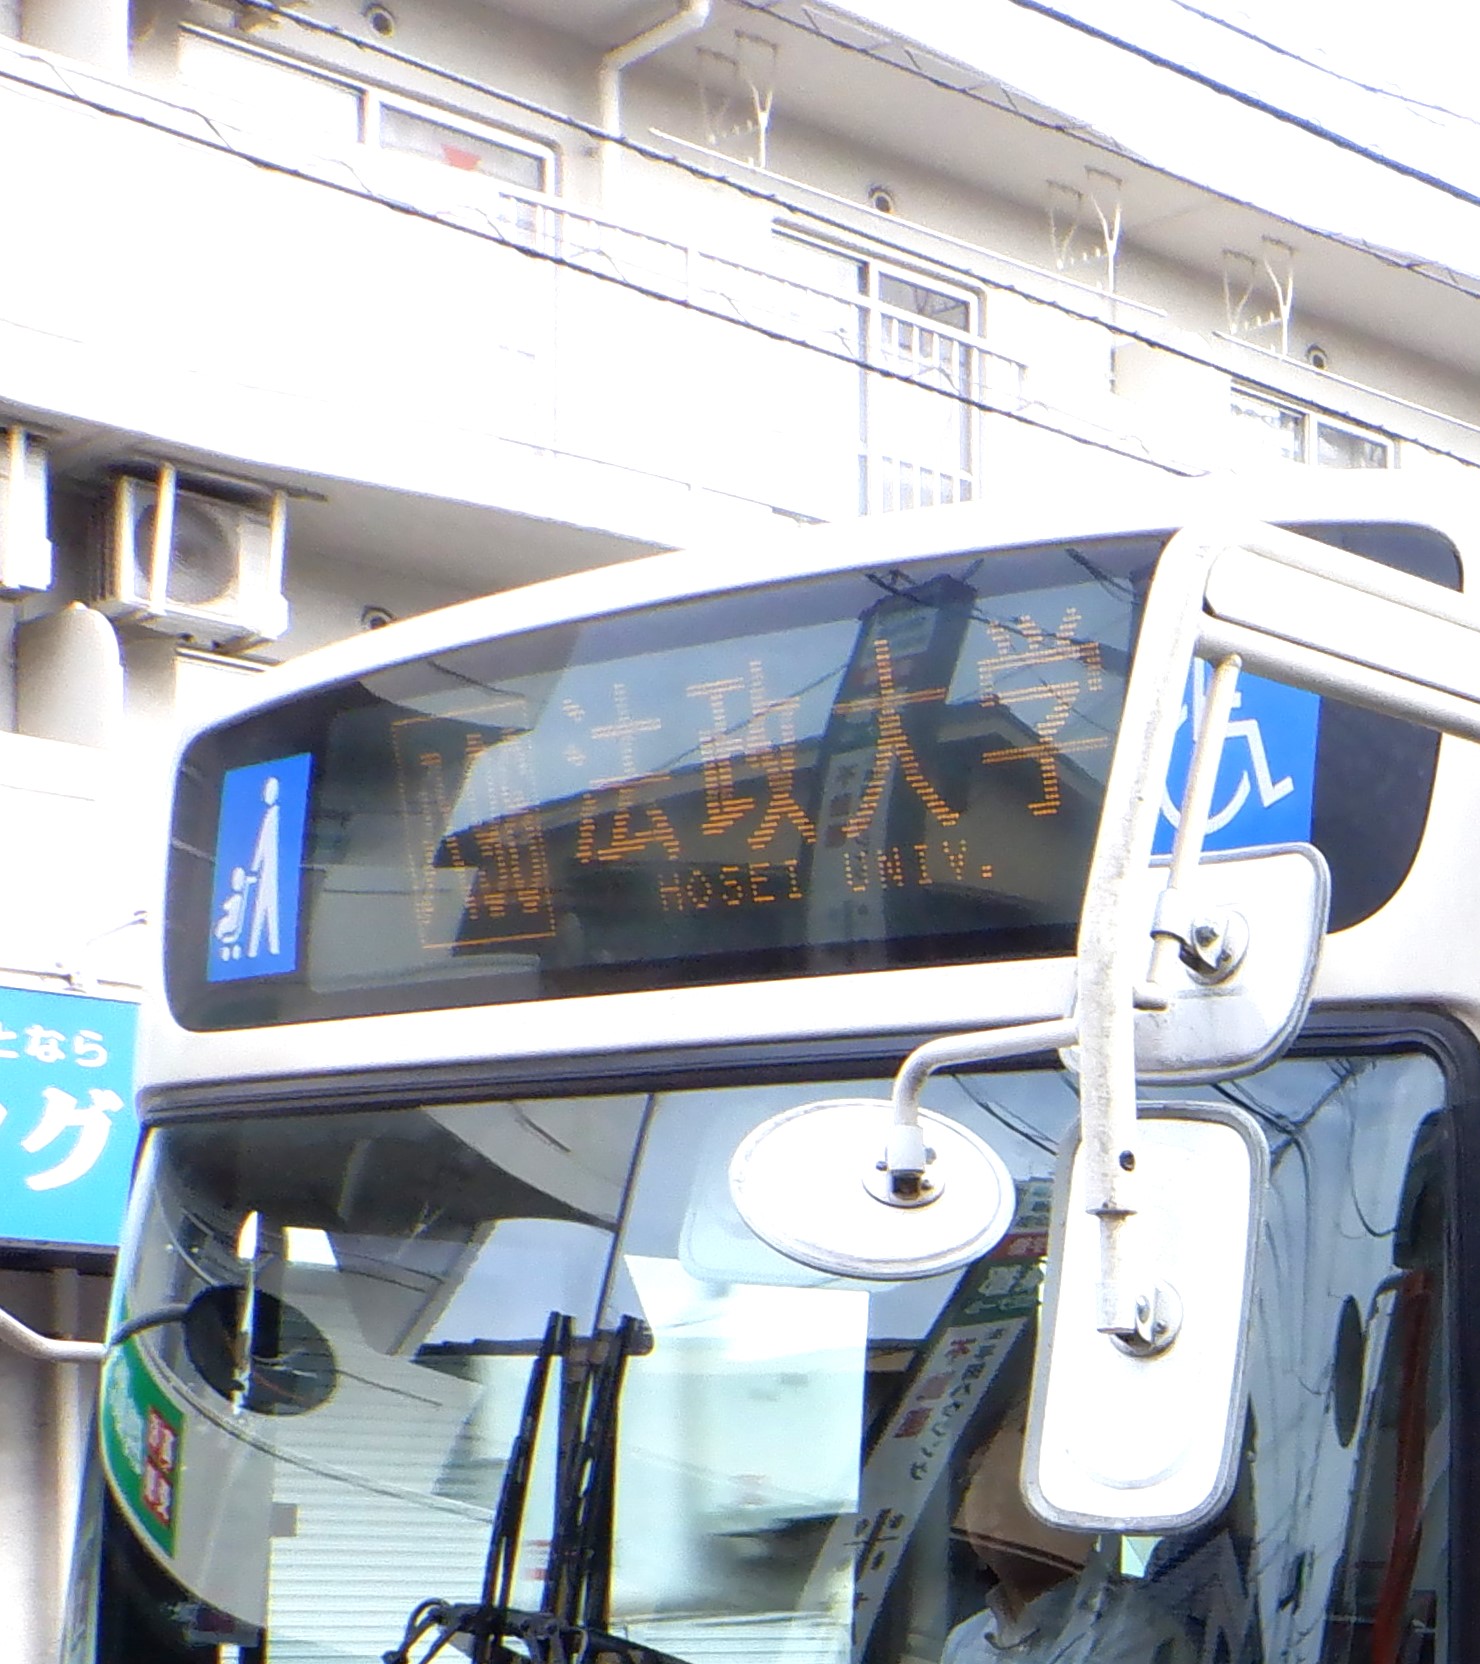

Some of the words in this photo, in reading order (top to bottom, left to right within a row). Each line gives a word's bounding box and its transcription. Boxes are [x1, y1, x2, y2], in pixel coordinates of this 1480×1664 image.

[562, 608, 1108, 863] 法政大学
[659, 859, 803, 913] HOSEI
[845, 840, 993, 892] UNIV.
[0, 1086, 124, 1192] グ
